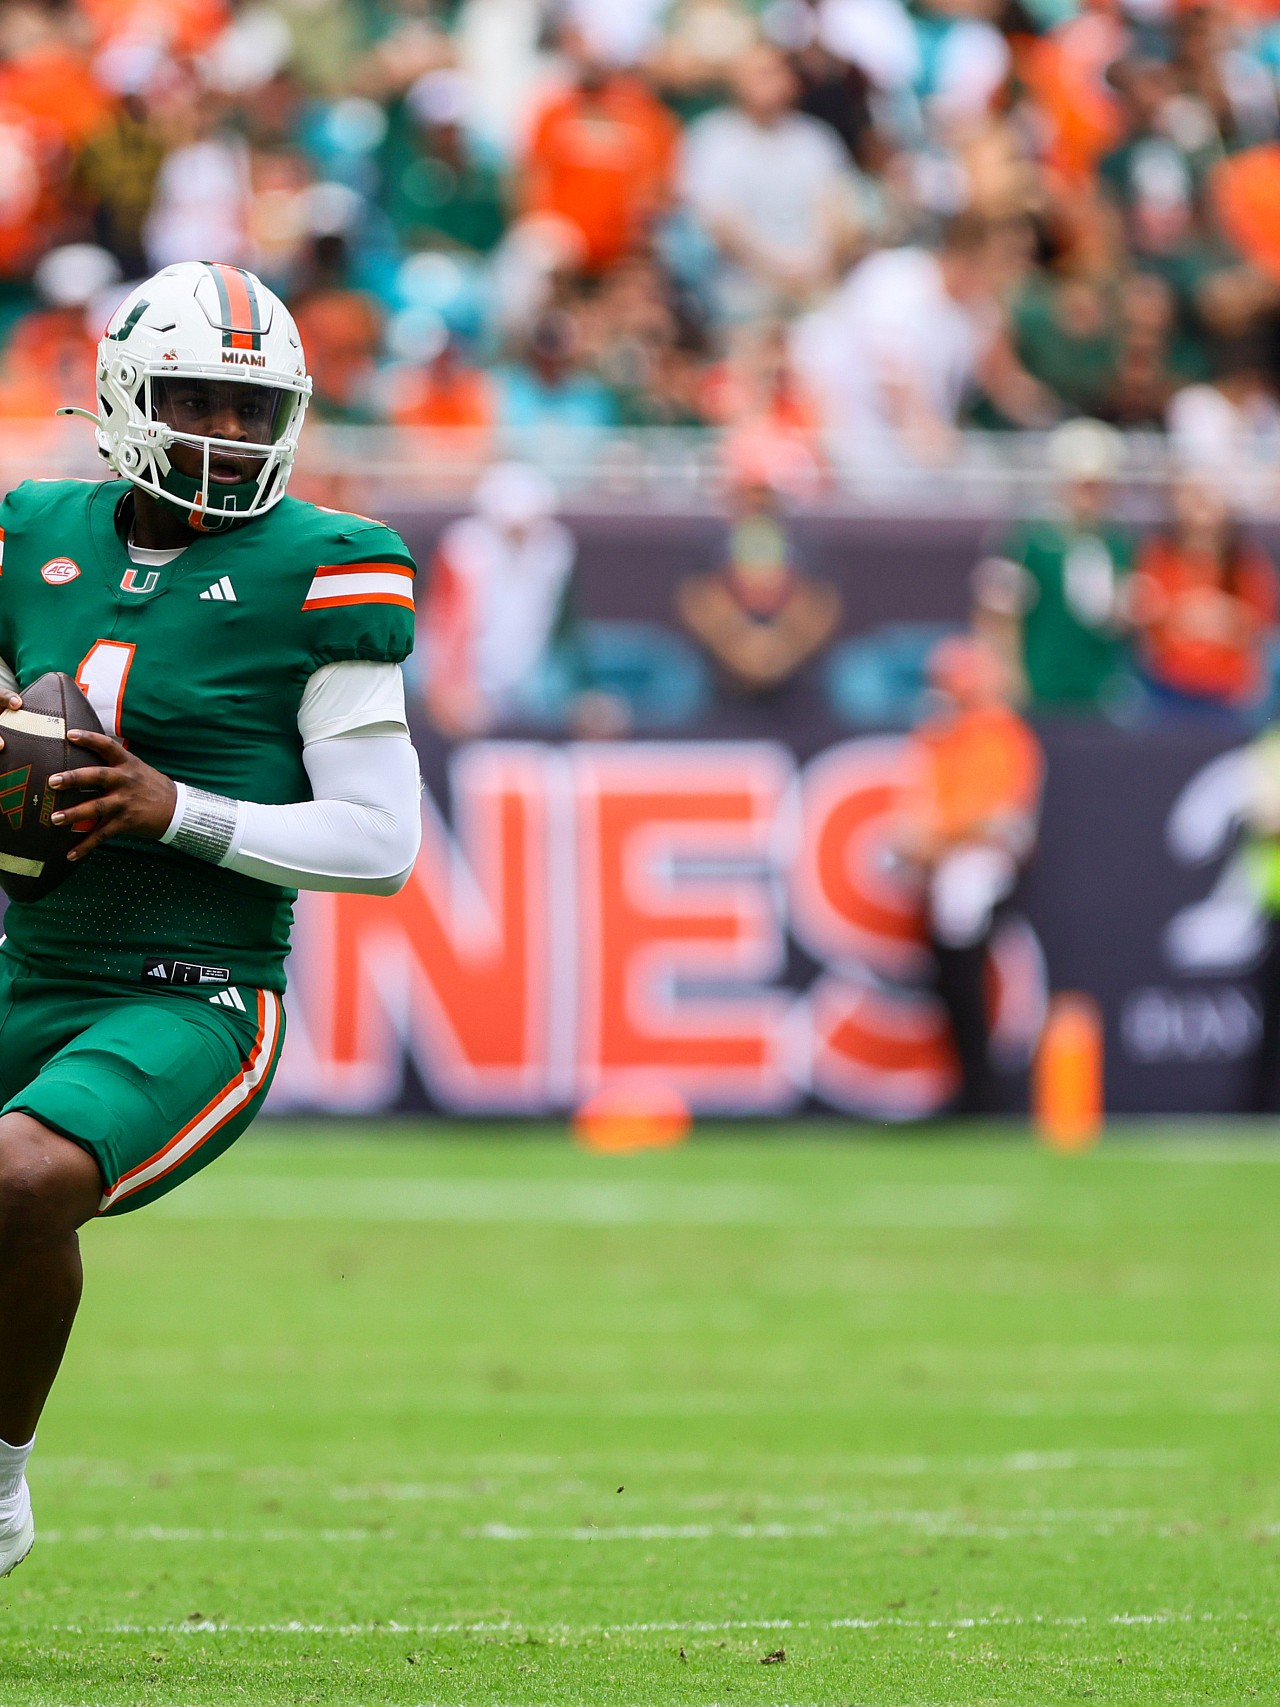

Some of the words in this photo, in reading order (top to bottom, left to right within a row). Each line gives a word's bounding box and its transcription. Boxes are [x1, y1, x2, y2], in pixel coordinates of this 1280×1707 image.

[221, 351, 266, 368] MIAMI
[188, 490, 237, 532] U
[48, 565, 74, 575] ACC
[120, 568, 160, 594] U
[75, 638, 137, 750] 1
[39, 775, 56, 828] DIM
